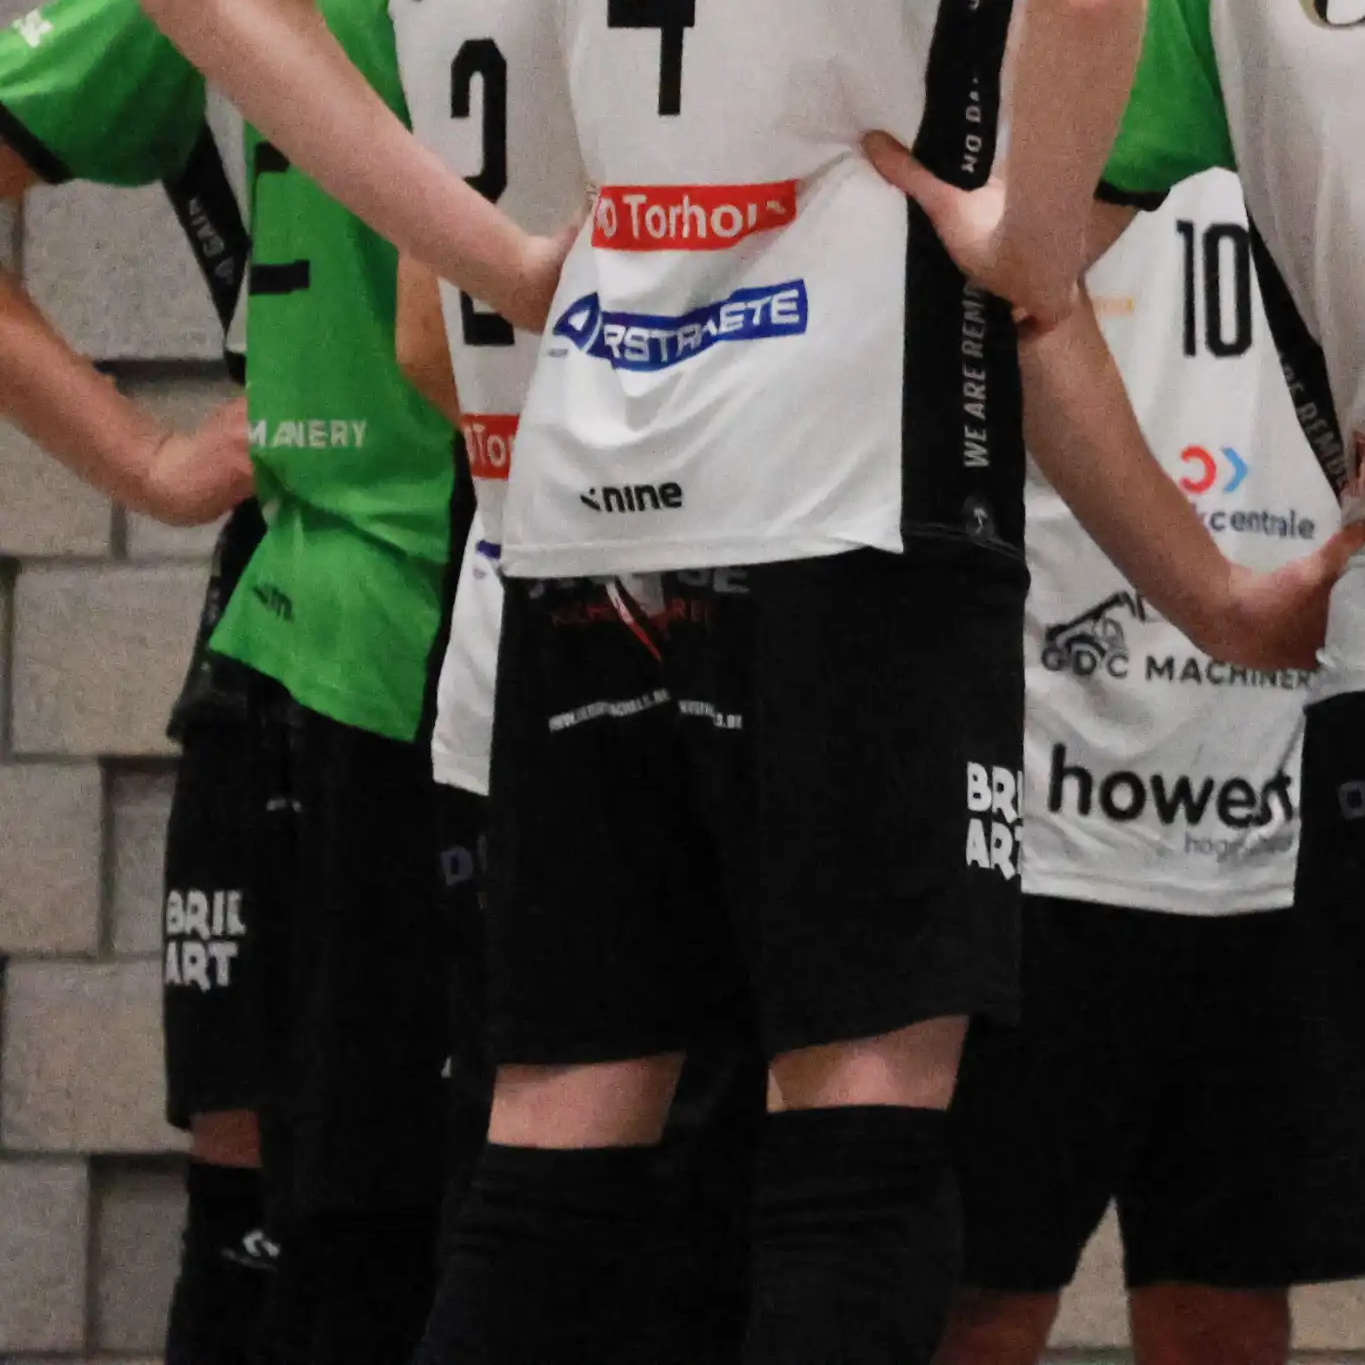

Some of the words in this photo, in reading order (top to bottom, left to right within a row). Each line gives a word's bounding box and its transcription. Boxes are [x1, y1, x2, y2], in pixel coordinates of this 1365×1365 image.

[1176, 220, 1253, 357] 10
[963, 363, 986, 420] ARE
[963, 425, 990, 468] WE
[602, 480, 683, 514] nine
[164, 940, 239, 992] ART
